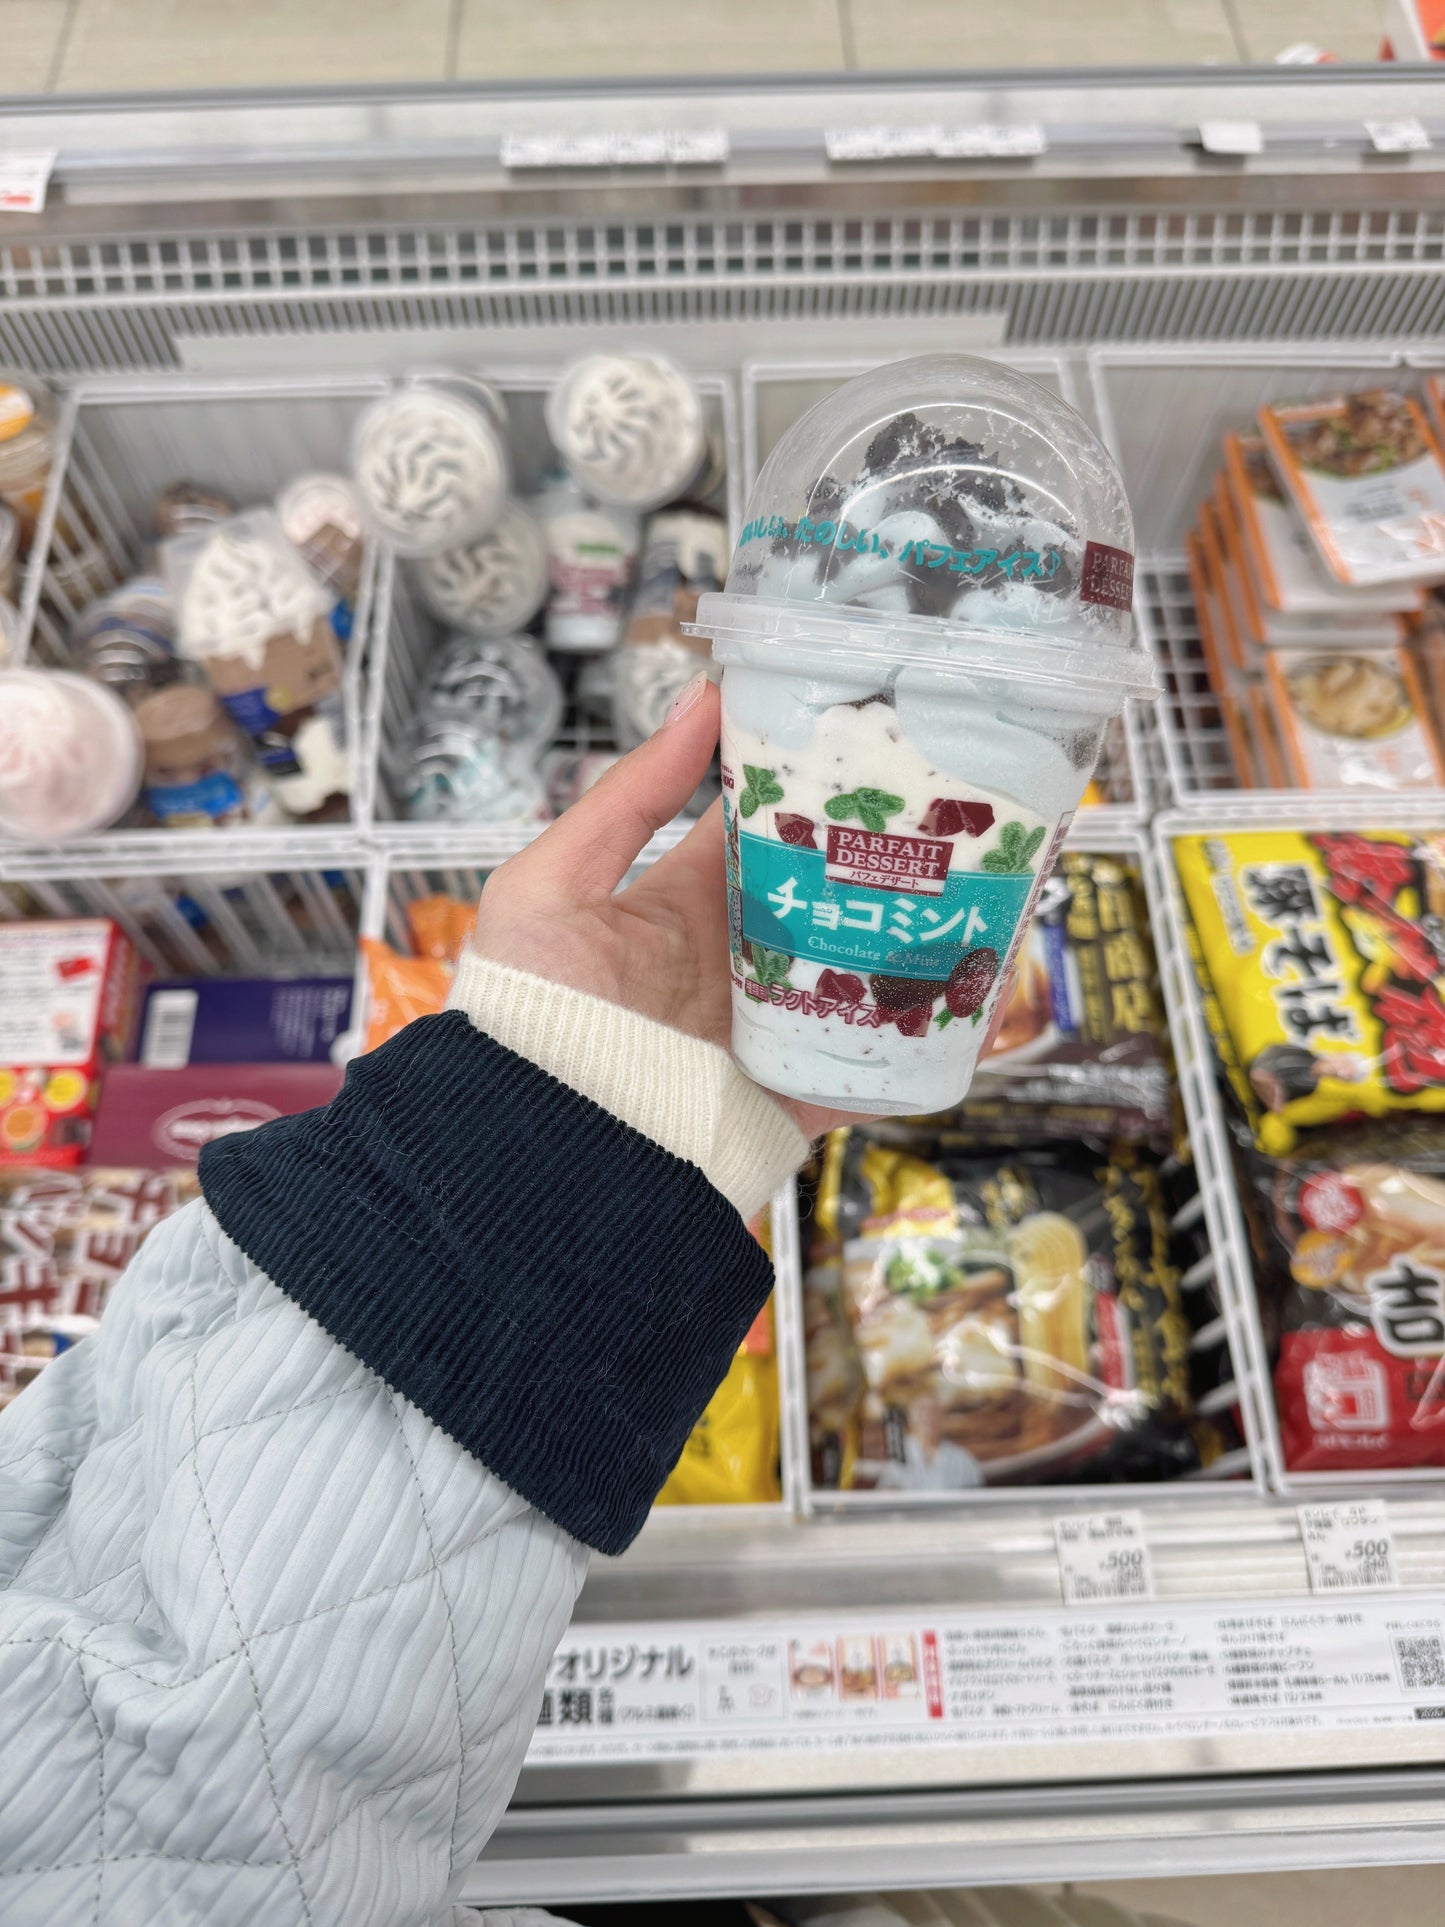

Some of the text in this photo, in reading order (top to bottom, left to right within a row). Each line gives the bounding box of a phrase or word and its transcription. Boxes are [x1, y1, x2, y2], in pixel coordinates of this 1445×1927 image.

[838, 831, 943, 860] PARFAIT
[836, 847, 939, 877] DESSERT
[851, 870, 920, 889] パフェデザート
[767, 876, 989, 948] チョコミント
[807, 936, 881, 960] Chocolate
[769, 981, 881, 1028] ラクトアイス
[547, 1643, 694, 1682] オリジナル
